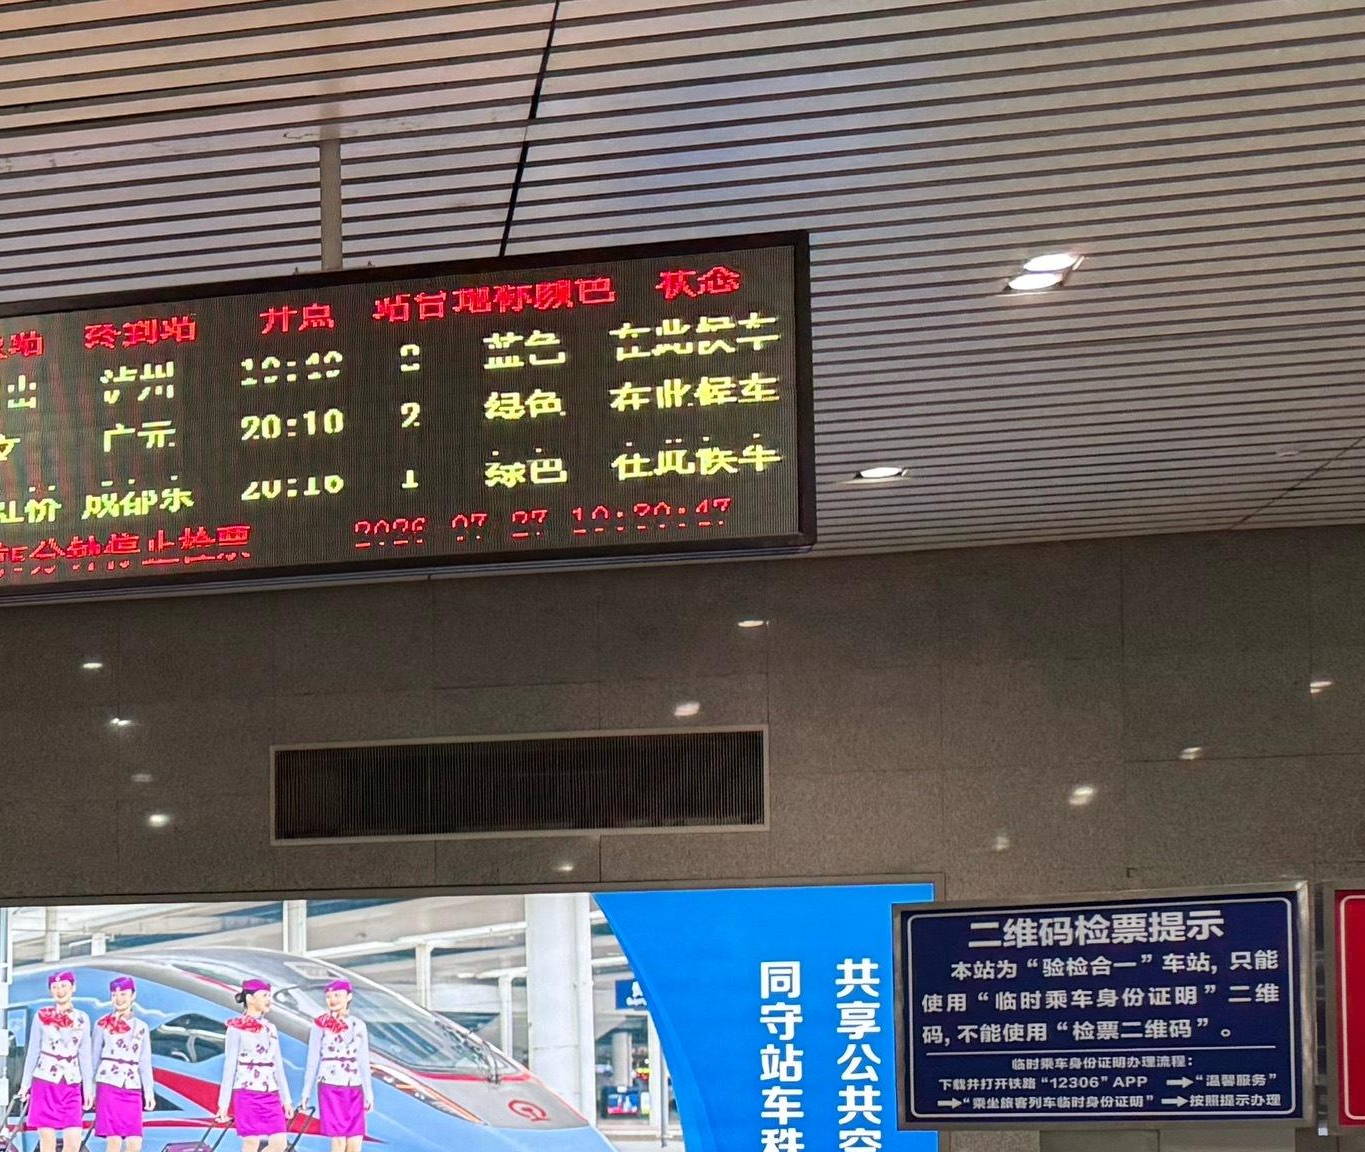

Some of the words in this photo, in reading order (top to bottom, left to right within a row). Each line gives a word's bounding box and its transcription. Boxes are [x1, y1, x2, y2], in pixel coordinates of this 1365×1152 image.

[103, 420, 176, 453] 广元
[241, 409, 344, 441] 20:10
[400, 402, 421, 428] 2
[484, 388, 567, 422] 绿色
[609, 372, 780, 413] 在此候车
[968, 910, 1225, 950] 二维码检票提示
[1113, 1075, 1149, 1089] APP
[1189, 1093, 1282, 1109] 按照提示办理
